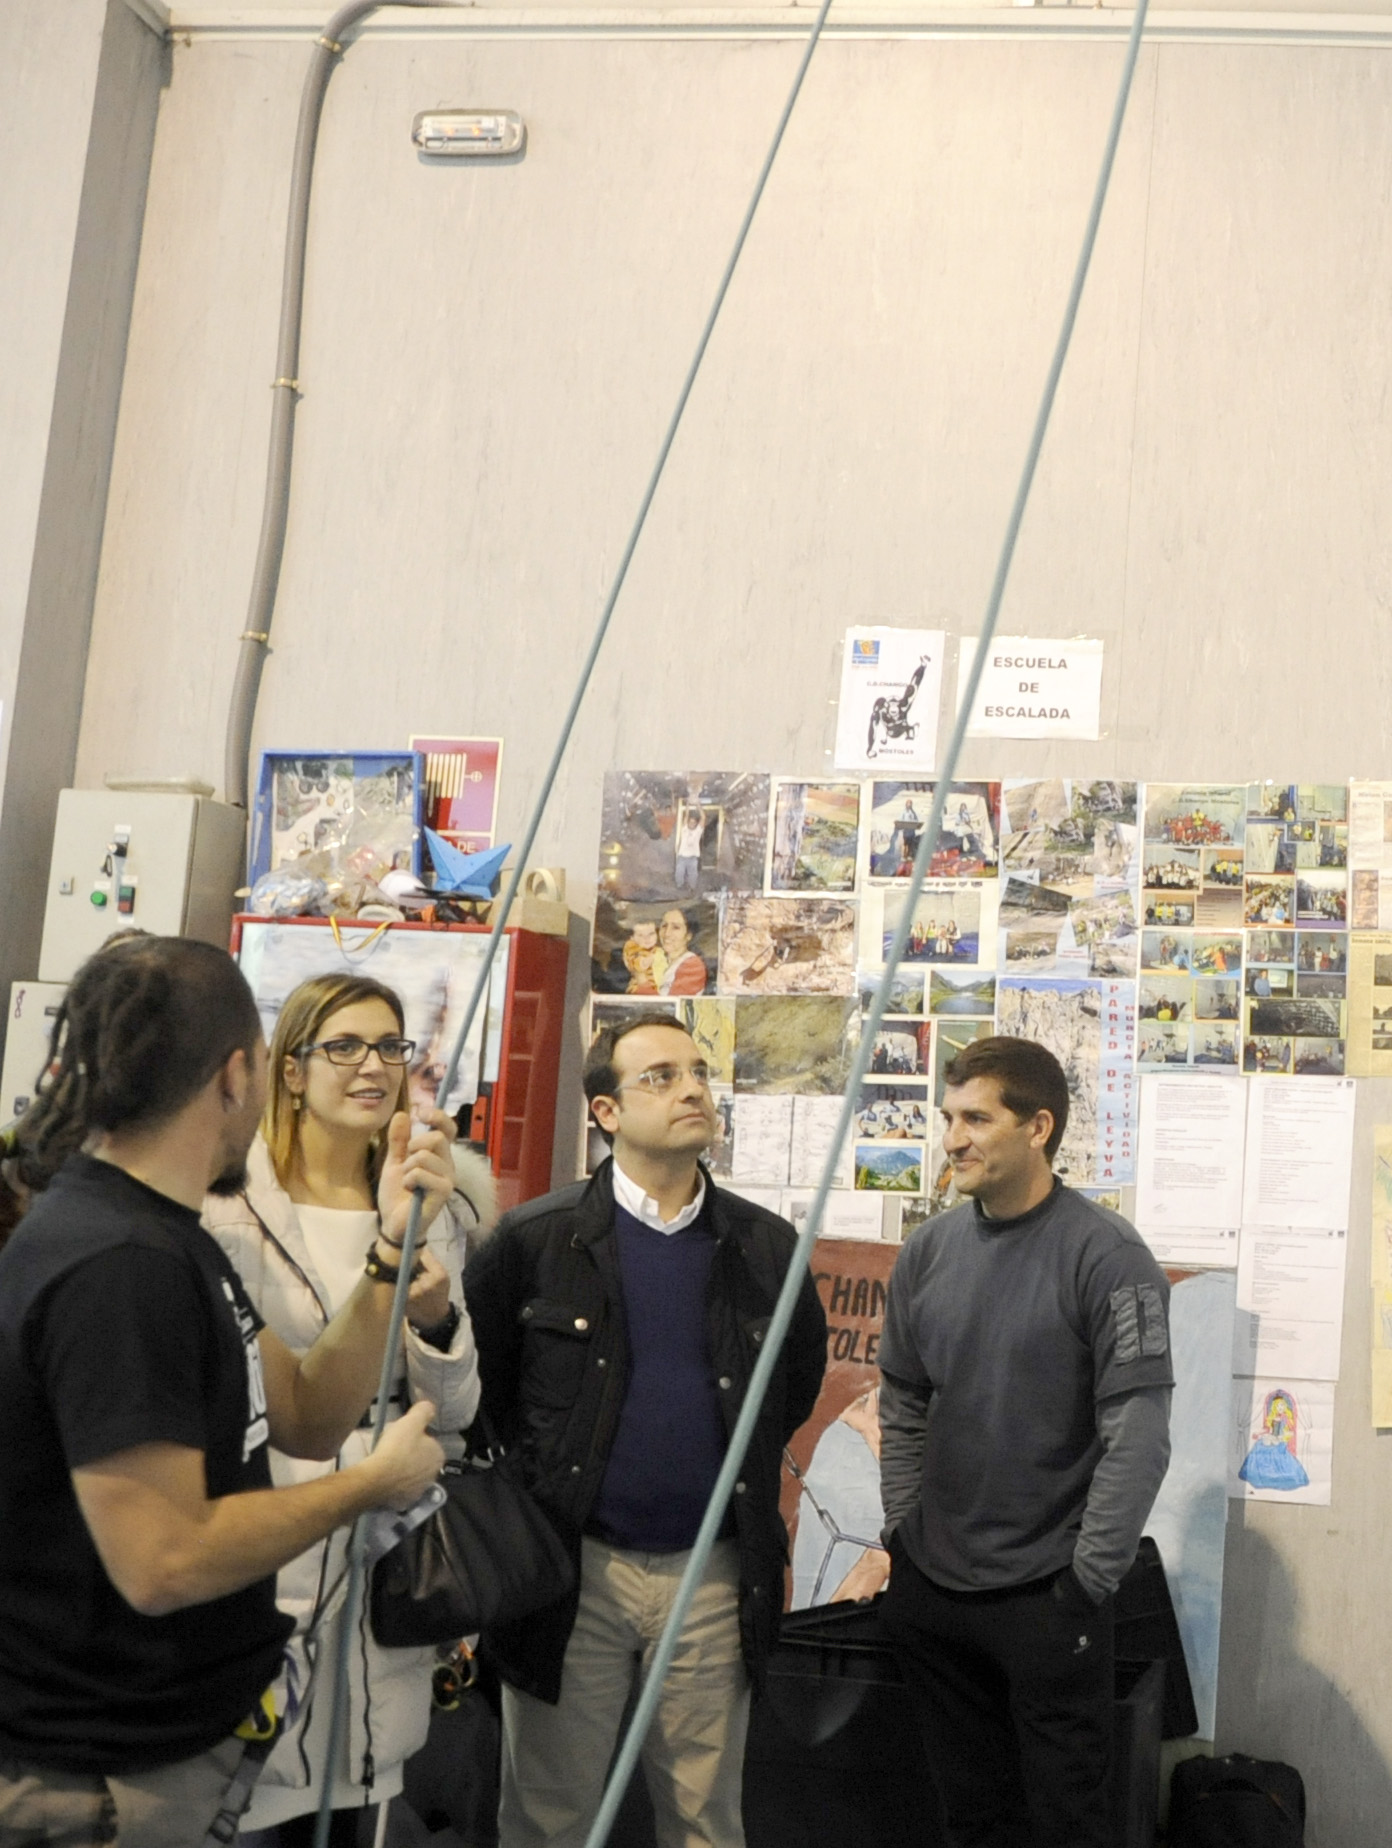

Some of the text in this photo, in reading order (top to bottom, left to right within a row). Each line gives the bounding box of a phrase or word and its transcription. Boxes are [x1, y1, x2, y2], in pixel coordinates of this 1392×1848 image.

[993, 656, 1068, 669] ESCUELA
[1018, 682, 1040, 694] DE
[984, 706, 1071, 720] ESCALADA
[458, 840, 476, 854] DE
[1108, 985, 1119, 1052] PARED
[1103, 1111, 1115, 1178] LEYVA
